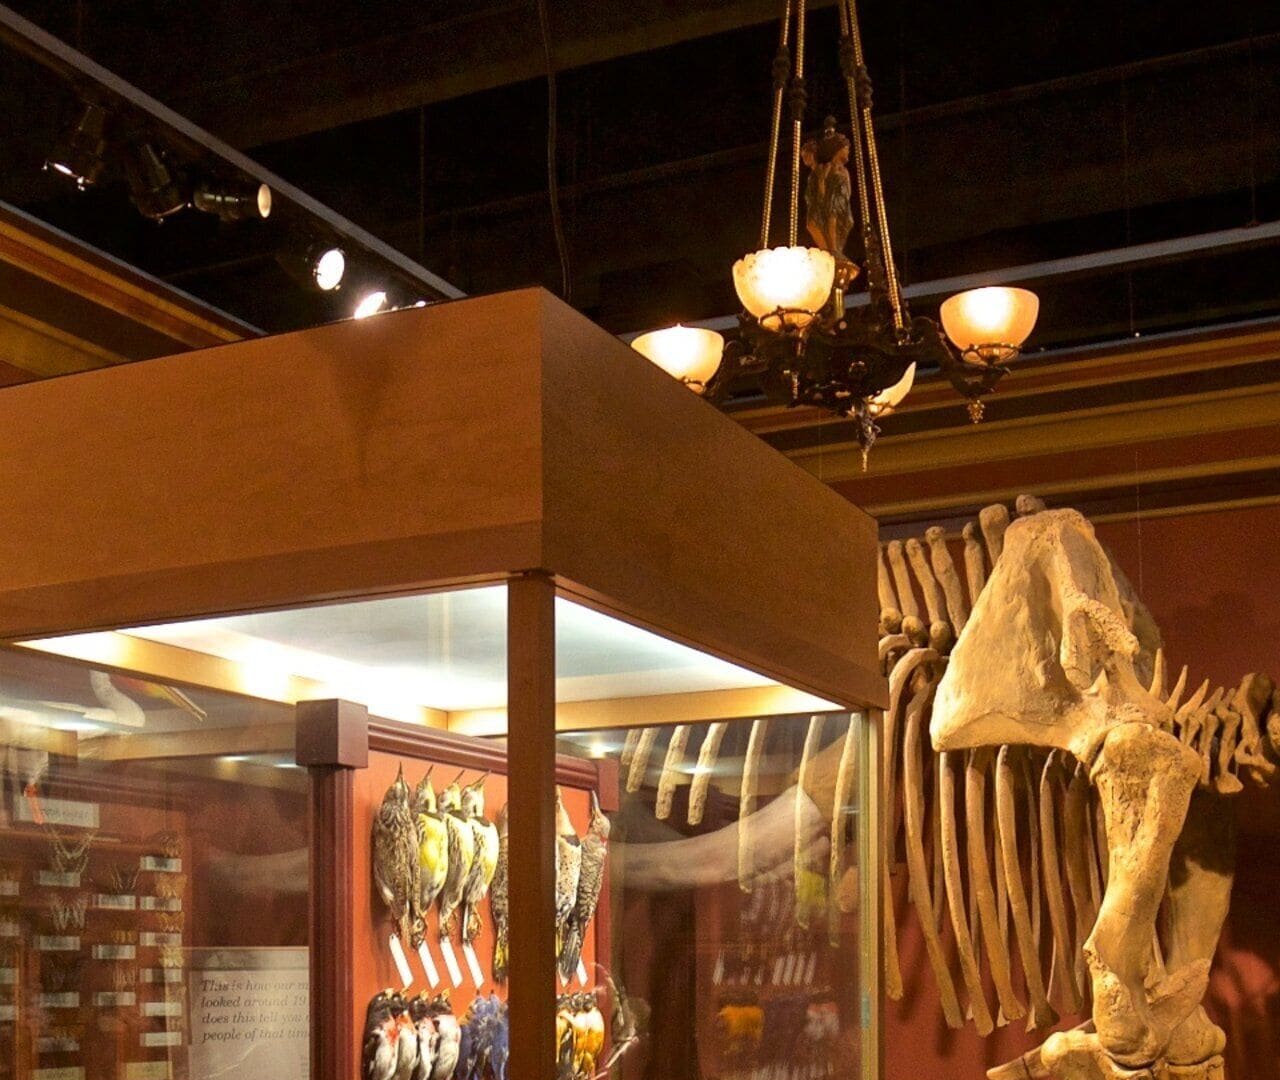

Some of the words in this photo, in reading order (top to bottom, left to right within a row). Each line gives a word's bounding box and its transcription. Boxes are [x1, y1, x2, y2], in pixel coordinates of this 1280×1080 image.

[201, 979, 228, 992] This
[232, 981, 242, 992] is
[246, 980, 271, 990] how
[273, 981, 294, 990] our
[200, 996, 240, 1008] looked
[243, 995, 288, 1007] around
[202, 1013, 229, 1024] does
[232, 1011, 255, 1023] this
[259, 1012, 277, 1023] tell
[281, 1014, 302, 1025] you
[202, 1028, 241, 1043] people
[244, 1027, 257, 1042] of
[260, 1029, 284, 1038] that
[287, 1029, 308, 1038] tim
